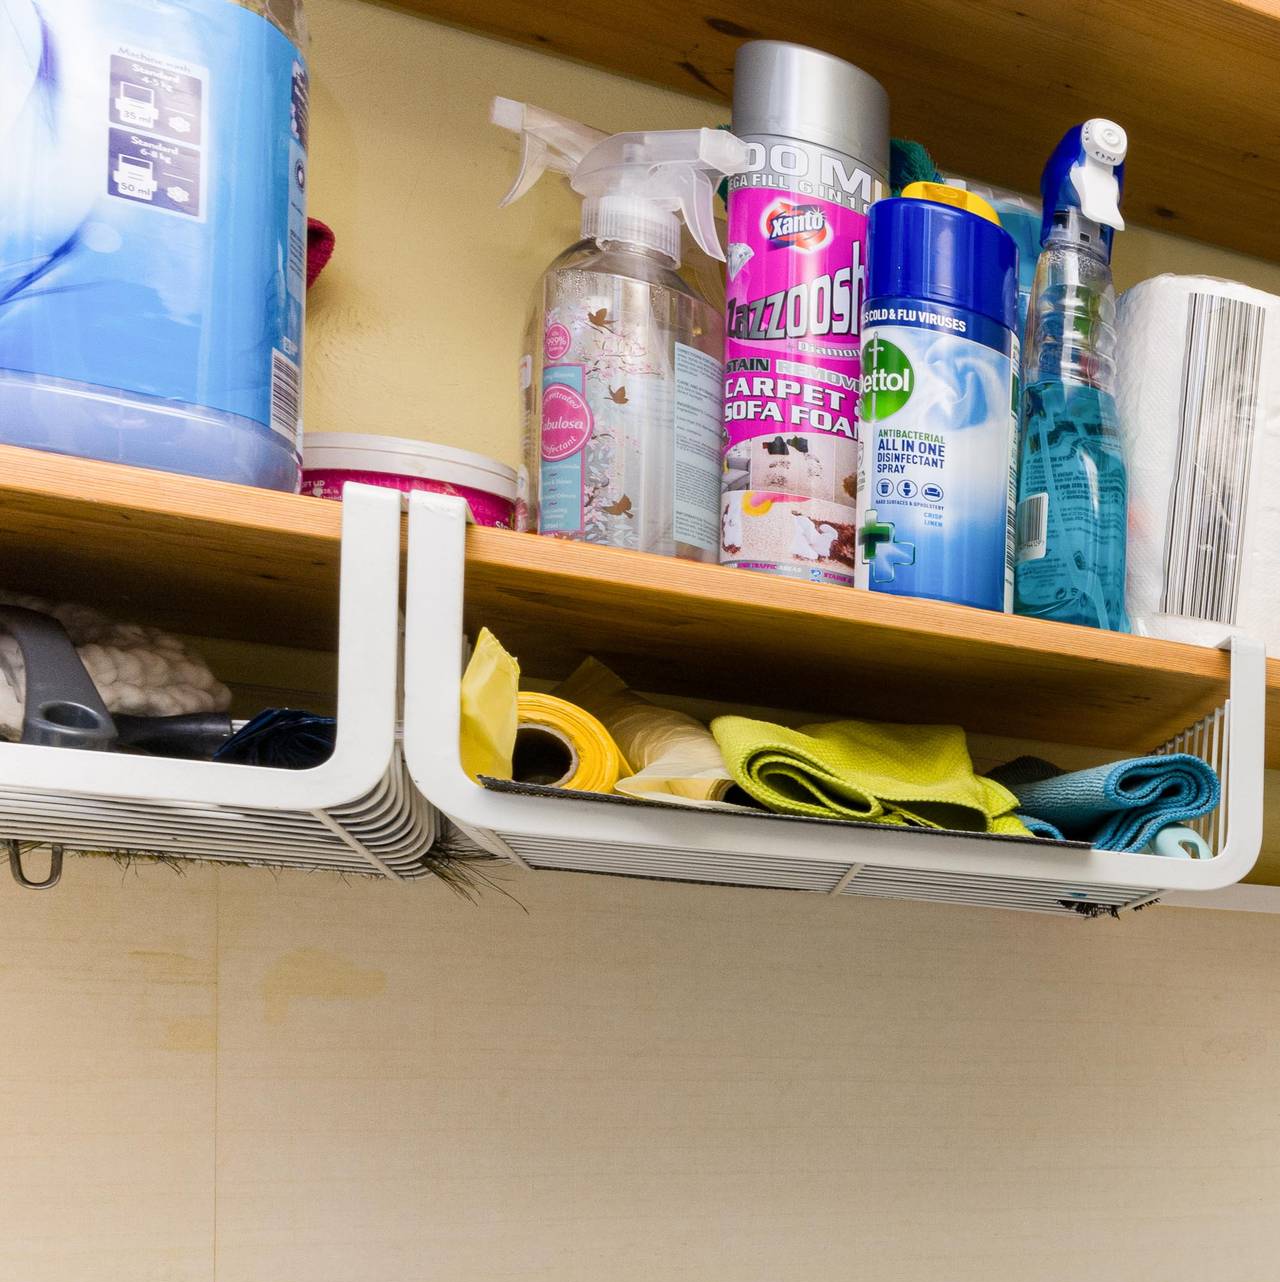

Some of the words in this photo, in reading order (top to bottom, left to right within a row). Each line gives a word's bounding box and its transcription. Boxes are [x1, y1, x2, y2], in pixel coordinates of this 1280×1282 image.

[131, 63, 180, 83] Standard
[123, 110, 137, 120] 35
[130, 135, 179, 156] Standard
[121, 182, 136, 193] 50
[728, 175, 749, 191] EGA
[752, 173, 790, 189] FILL
[800, 181, 814, 194] 6
[819, 185, 842, 204] IN
[770, 211, 825, 239] xanto
[868, 308, 888, 321] COLD
[889, 308, 897, 320] &
[897, 308, 917, 322] FLU
[917, 311, 967, 333] VIRUSES
[797, 341, 860, 357] Diamon
[726, 357, 770, 374] STAIN
[725, 377, 846, 411] CARPET
[724, 400, 784, 423] SOFA
[543, 416, 585, 431] abulosa
[878, 428, 946, 445] ANTIBACTERIAL
[878, 438, 899, 452] ALL
[901, 439, 915, 453] IN
[918, 441, 945, 458] ONE
[876, 463, 906, 474] SPRAY
[877, 452, 945, 470] DISINFECTANT
